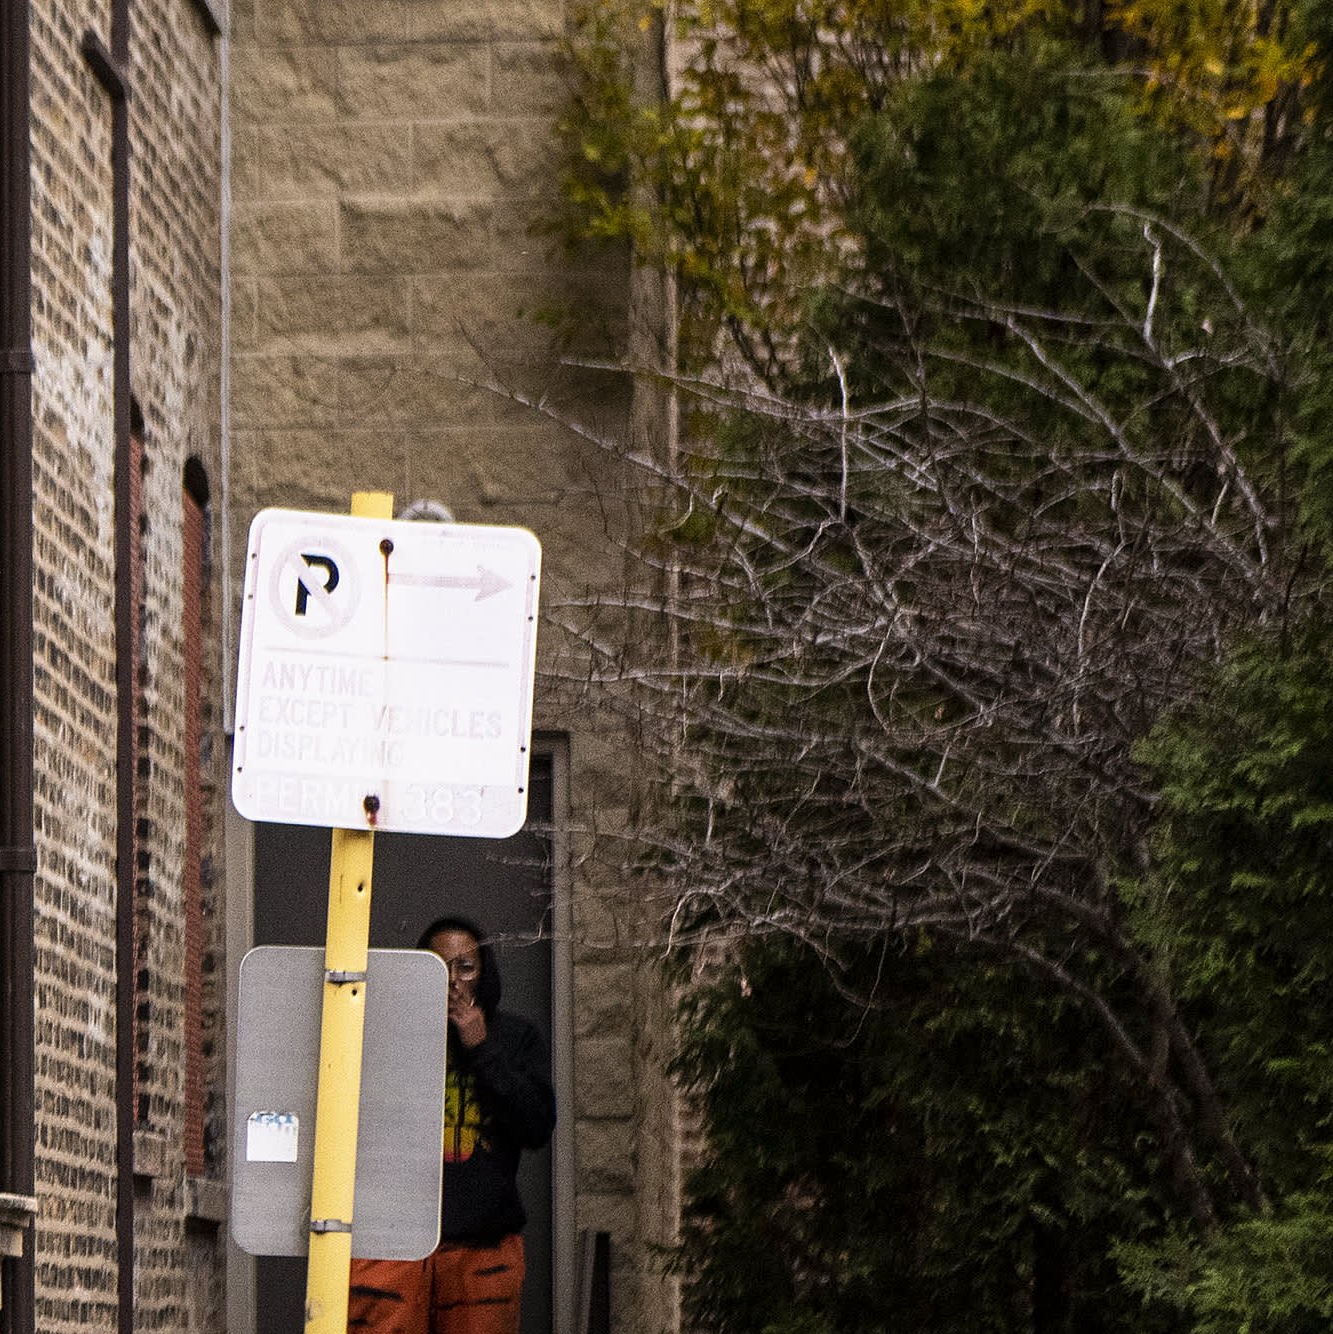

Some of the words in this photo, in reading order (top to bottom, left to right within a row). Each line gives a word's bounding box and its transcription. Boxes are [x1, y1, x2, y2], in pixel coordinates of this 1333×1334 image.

[260, 660, 374, 697] ANYTIME
[257, 695, 353, 729] EXCEPT
[373, 703, 503, 740] VEHICLES
[255, 730, 406, 769] DISPLAYING
